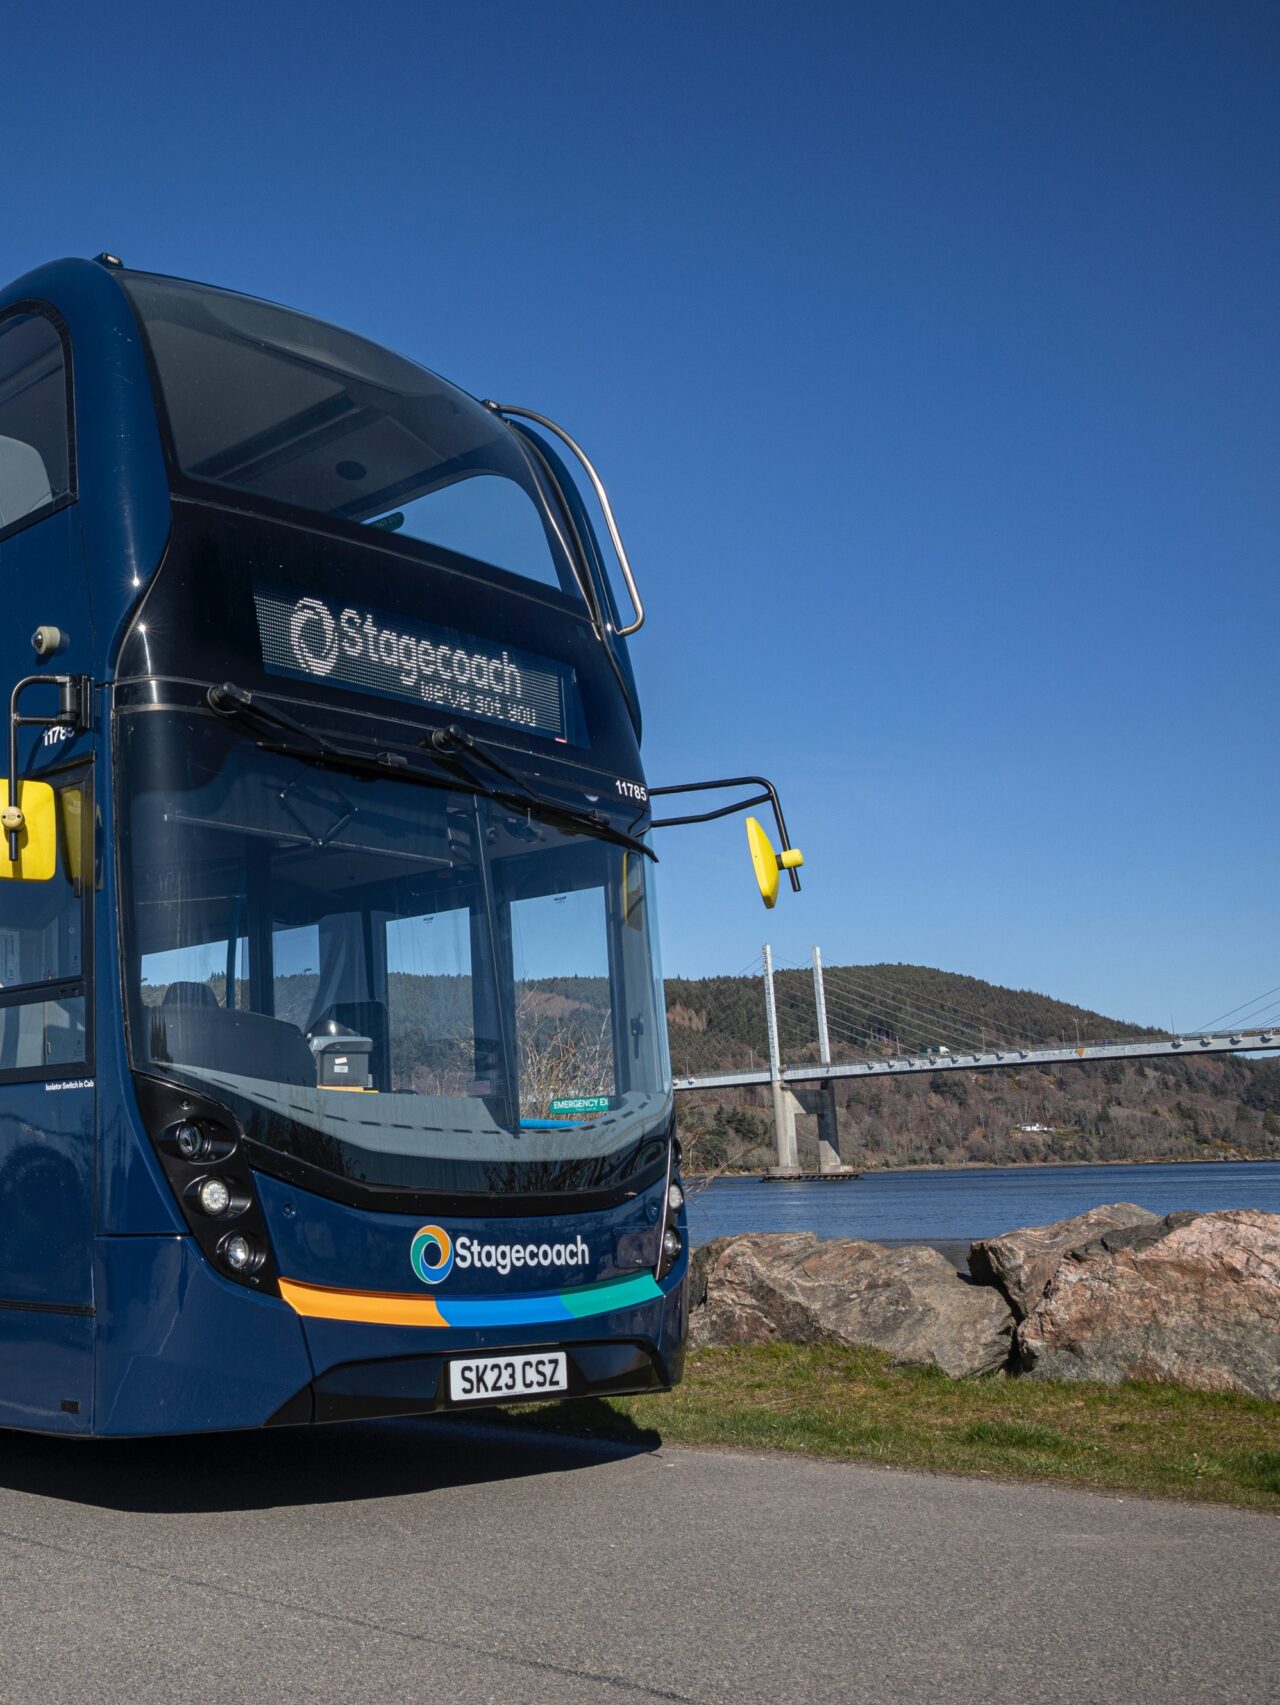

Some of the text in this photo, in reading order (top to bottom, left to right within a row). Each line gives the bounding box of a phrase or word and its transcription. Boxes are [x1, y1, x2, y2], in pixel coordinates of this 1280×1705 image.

[340, 608, 521, 697] Stagecoach
[507, 703, 536, 727] you
[616, 780, 647, 801] 11785
[62, 1081, 78, 1089] Switch
[553, 1098, 598, 1110] EMERGENCY
[455, 1235, 590, 1275] Stagecoach
[460, 1358, 560, 1394] SK23 CSZ
